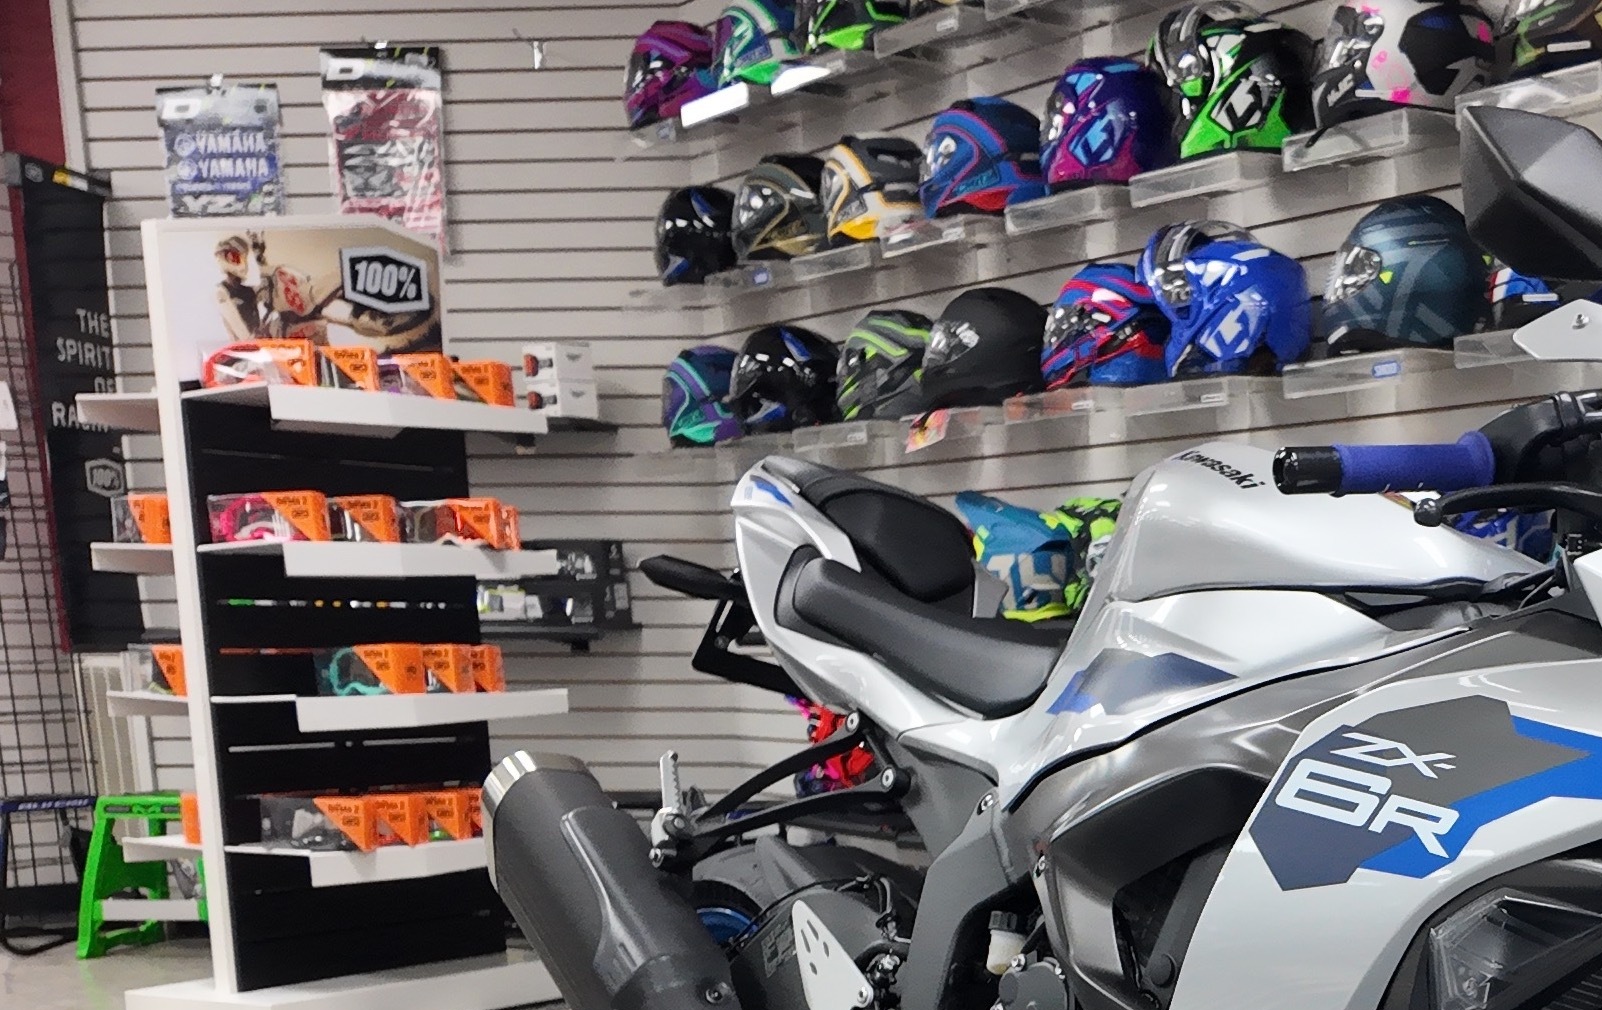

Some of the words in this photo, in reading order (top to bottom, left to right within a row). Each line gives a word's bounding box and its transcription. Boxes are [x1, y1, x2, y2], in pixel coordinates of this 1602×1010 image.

[196, 130, 267, 155] YAMAHA
[198, 157, 269, 179] YAMAHA
[355, 260, 418, 300] 100%
[75, 308, 111, 339] THE
[56, 336, 111, 371] SPIRIT
[1274, 757, 1461, 859] 6R
